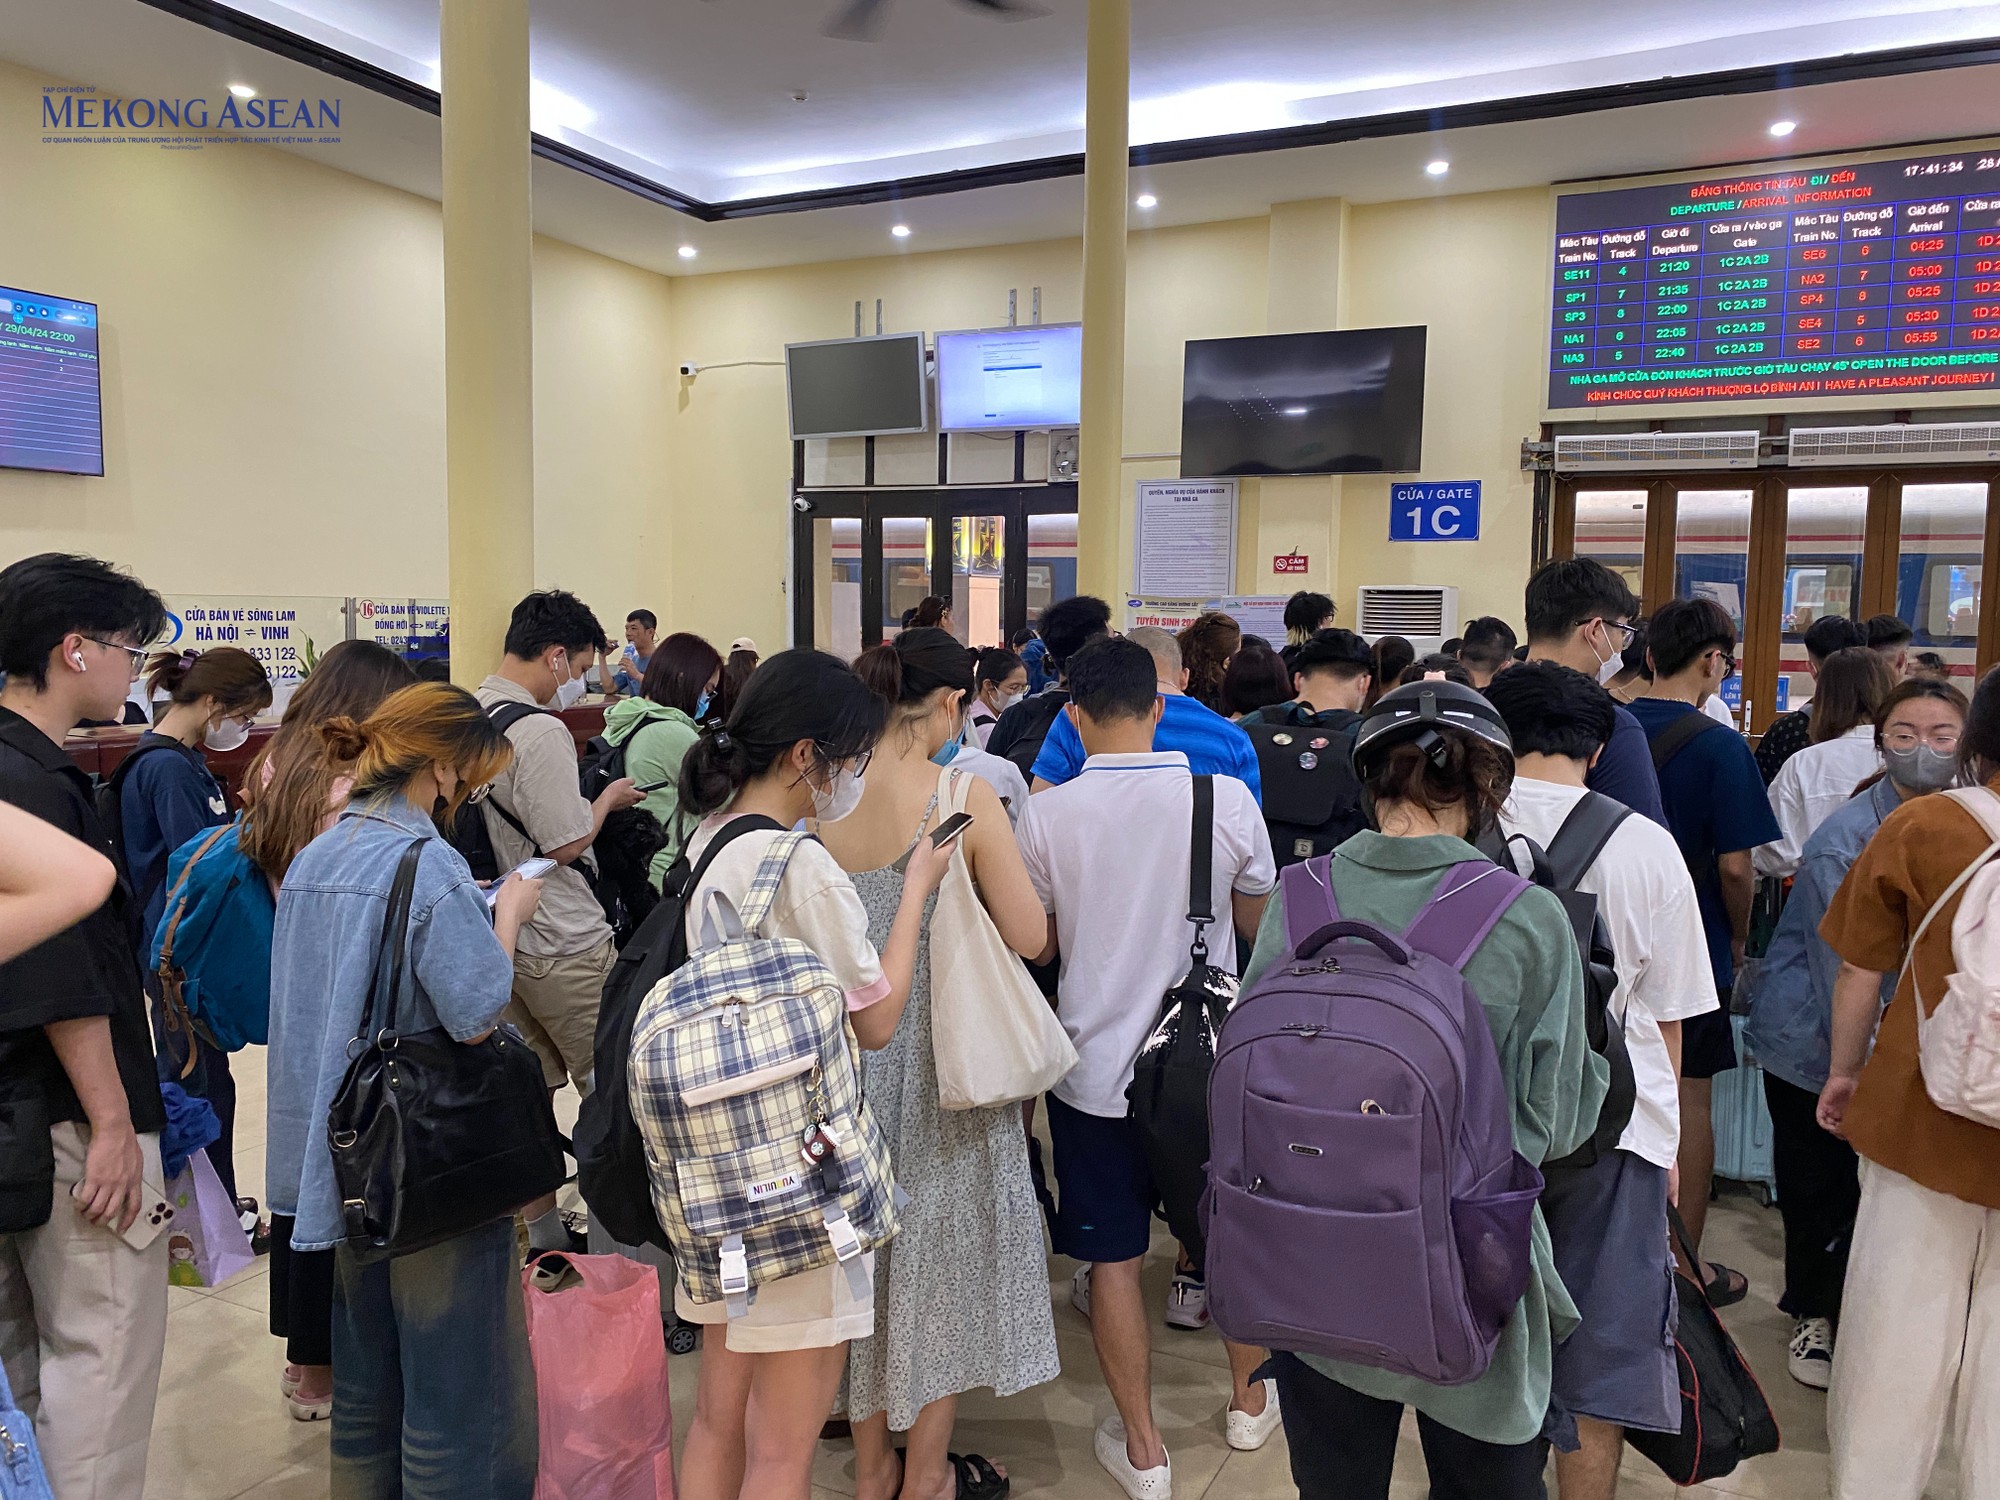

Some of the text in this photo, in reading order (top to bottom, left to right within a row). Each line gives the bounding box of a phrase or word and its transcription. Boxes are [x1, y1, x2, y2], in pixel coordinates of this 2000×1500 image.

[1906, 162, 1963, 176] 17:41:34
[1691, 170, 1855, 197] BẢNG THÔNG TIN TÀU ĐẾN
[1671, 187, 1871, 215] DEPARTURE INFORMATION
[1908, 203, 1949, 216] Giờ đến
[1795, 214, 1838, 226] Mác Tàu
[1843, 211, 1877, 222] Đường
[1769, 221, 1782, 230] ga
[1908, 221, 1943, 232] Arrival
[1794, 231, 1838, 242] Train No.
[1852, 226, 1881, 237] Track
[1581, 237, 1598, 246] Tàu
[1734, 238, 1757, 247] Gate
[1910, 239, 1944, 252] 04:25
[1977, 236, 1994, 246] 1D
[1610, 249, 1636, 258] Track
[1653, 244, 1698, 256] Departure
[1803, 249, 1827, 260] SE6
[1862, 246, 1869, 256] 6
[1559, 252, 1598, 263] Train No.
[1720, 254, 1769, 267] 1C 2A 2B
[1619, 267, 1626, 275] 4
[1660, 261, 1689, 272] 21:20
[1909, 265, 1942, 277] 05:00
[1976, 261, 1993, 272] 1D
[1564, 270, 1589, 280] SE11
[1801, 274, 1824, 284] NA2
[1860, 271, 1868, 280] 7
[1659, 285, 1688, 295] 21:35
[1719, 279, 1768, 291] 1C 2A 2B
[1974, 282, 1991, 293] 1D
[1619, 290, 1625, 299] 7
[1859, 291, 1866, 300] 8
[1907, 286, 1941, 297] 05:25
[1566, 293, 1585, 303] SP1
[1800, 294, 1823, 305] SP4
[1658, 304, 1687, 315] 22:00
[1718, 298, 1766, 311] 1C 2A 2B
[1565, 312, 1585, 321] SP3
[1617, 309, 1624, 318] 8
[1906, 310, 1939, 322] 05:30
[1972, 307, 1989, 318] 1D
[1799, 318, 1822, 329] SE4
[1857, 315, 1864, 325] 5
[5, 323, 75, 342] 29/04/24 22:00
[1657, 328, 1686, 338] 22:05
[1716, 322, 1765, 334] 1C 2A 2B
[1564, 334, 1584, 344] NA1
[1616, 332, 1623, 340] 6
[1905, 332, 1937, 343] 05:55
[1971, 329, 1987, 339] 1D
[1797, 339, 1820, 349] SE2
[1856, 336, 1864, 346] 6
[1656, 348, 1685, 358] 22:40
[1715, 343, 1763, 354] 1C 2A 2B
[1563, 354, 1584, 363] NA3
[1615, 351, 1622, 360] 5
[1570, 374, 1591, 384] NHÀ
[1593, 375, 1608, 383] GA
[1675, 369, 1712, 379] KHÁCH
[1776, 363, 1798, 373] TÀU
[1800, 362, 1831, 373] CHẠY
[1851, 359, 1883, 369] OPEN
[1886, 358, 1909, 367] THE
[1912, 356, 1947, 366] DOOR
[1949, 353, 1998, 365] BEFORE
[1613, 390, 1642, 400] CHÚC
[1668, 386, 1705, 397] KHÁCH
[1799, 381, 1815, 391] AN
[1825, 379, 1856, 389] HAVE
[1858, 379, 1868, 388] A
[1869, 376, 1930, 387] PLEASANT
[1931, 373, 1989, 385] JOURNEY
[1397, 487, 1424, 500] CỬA
[1436, 488, 1473, 499] GATE
[1406, 505, 1461, 536] 1C
[185, 605, 295, 621] CỬA BÁN VÉ SÔNG LAM
[362, 602, 373, 616] 16
[375, 602, 389, 614] CỬA
[391, 603, 405, 614] BÁN
[416, 606, 445, 615] VIOLETTE
[1136, 614, 1180, 627] TUYỂN SINH
[196, 624, 289, 643] HÀ NỘI VINH
[275, 647, 296, 660] 122
[276, 666, 296, 679] 122
